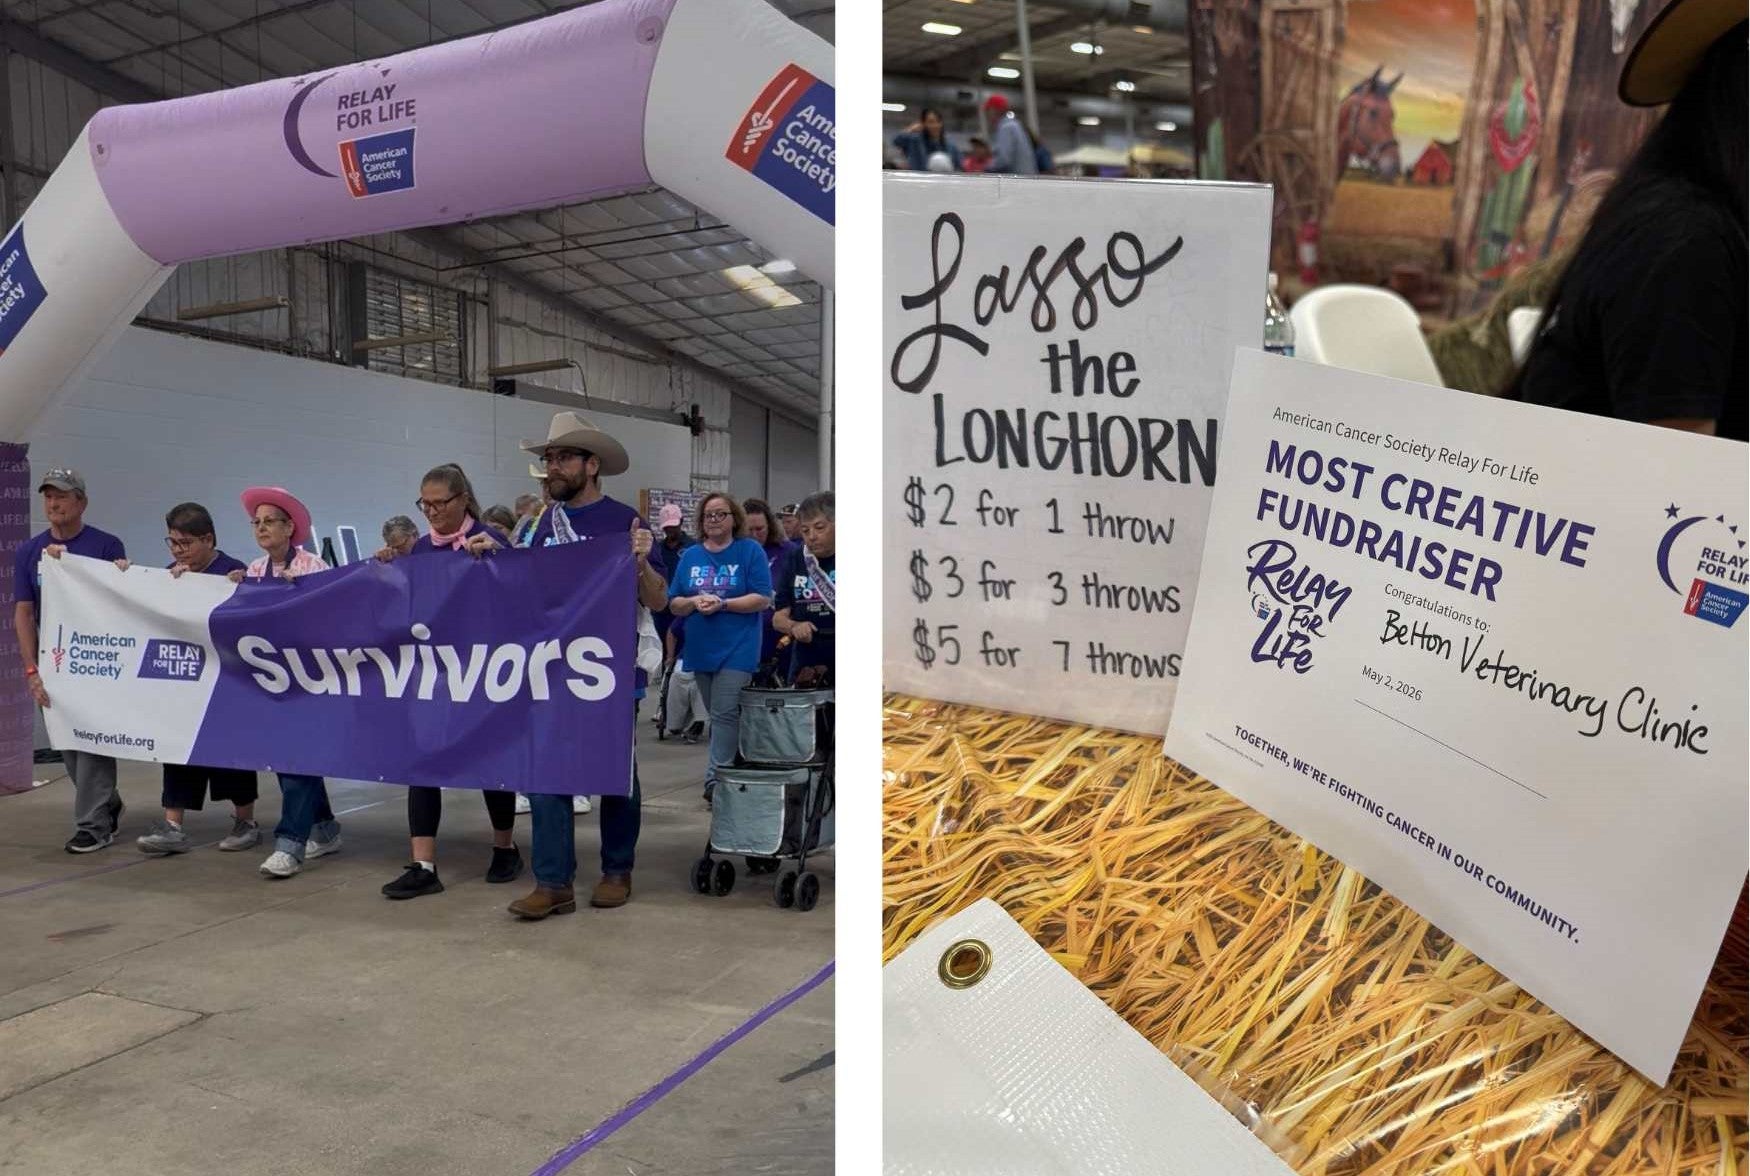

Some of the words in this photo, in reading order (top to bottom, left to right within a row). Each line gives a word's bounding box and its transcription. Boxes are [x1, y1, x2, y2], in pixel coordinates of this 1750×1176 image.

[337, 84, 396, 111] RELAY
[337, 110, 372, 131] FOR
[379, 99, 416, 123] LIFE
[361, 147, 408, 163] American
[363, 160, 397, 172] Cancer
[772, 138, 835, 193] Society
[366, 168, 402, 183] Society
[0, 282, 26, 322] ciety
[891, 212, 1184, 394] Lasso
[1040, 339, 1141, 398] the
[933, 393, 1218, 487] LONGHORN
[1272, 406, 1333, 434] American
[1335, 421, 1382, 447] Cancer
[1384, 433, 1437, 463] Society
[1438, 447, 1480, 474] Relay
[1482, 457, 1509, 479] For
[1510, 464, 1540, 486] Life
[904, 476, 958, 528] $2
[976, 488, 1020, 527] for
[1046, 498, 1064, 533] 1
[1083, 502, 1176, 545] throw
[1265, 439, 1375, 500] MOST
[1380, 472, 1596, 568] CREATIVE
[1256, 488, 1503, 602] FUNDRAISER
[1701, 547, 1748, 569] RELAY
[909, 549, 964, 603] $3
[978, 560, 1017, 602] for
[1047, 571, 1068, 606] 3
[1082, 572, 1182, 614] throws
[1697, 560, 1726, 579] FOR
[1384, 583, 1473, 626] Congratulations
[1475, 617, 1491, 634] to:
[1701, 603, 1729, 619] Society
[1703, 598, 1729, 611] Cancer
[1705, 592, 1741, 608] American
[69, 631, 136, 648] American
[69, 646, 120, 662] Cancer
[159, 643, 201, 661] RELAY
[912, 618, 961, 671] $5
[979, 631, 1021, 667] for
[1052, 640, 1070, 672] 7
[1086, 641, 1184, 678] throws
[69, 661, 122, 680] Society
[153, 660, 168, 669] FOR
[168, 661, 198, 677] LIFE
[237, 623, 617, 703] Survivors
[1361, 664, 1384, 686] May
[1384, 675, 1395, 691] 2,
[1396, 679, 1424, 701] 2026
[1380, 609, 1452, 660] Belton
[1461, 634, 1609, 737] Veterinary
[1617, 686, 1709, 755] Clinic
[73, 729, 155, 750] RelayForLife.org
[1235, 725, 1291, 767] TOGETHER,
[1292, 757, 1328, 785] WE'RE
[1328, 778, 1384, 819] FIGHTING
[1386, 811, 1435, 850] CANCER
[1436, 841, 1452, 861] IN
[1453, 854, 1484, 882] OUR
[1485, 874, 1580, 944] COMMUNITY.
